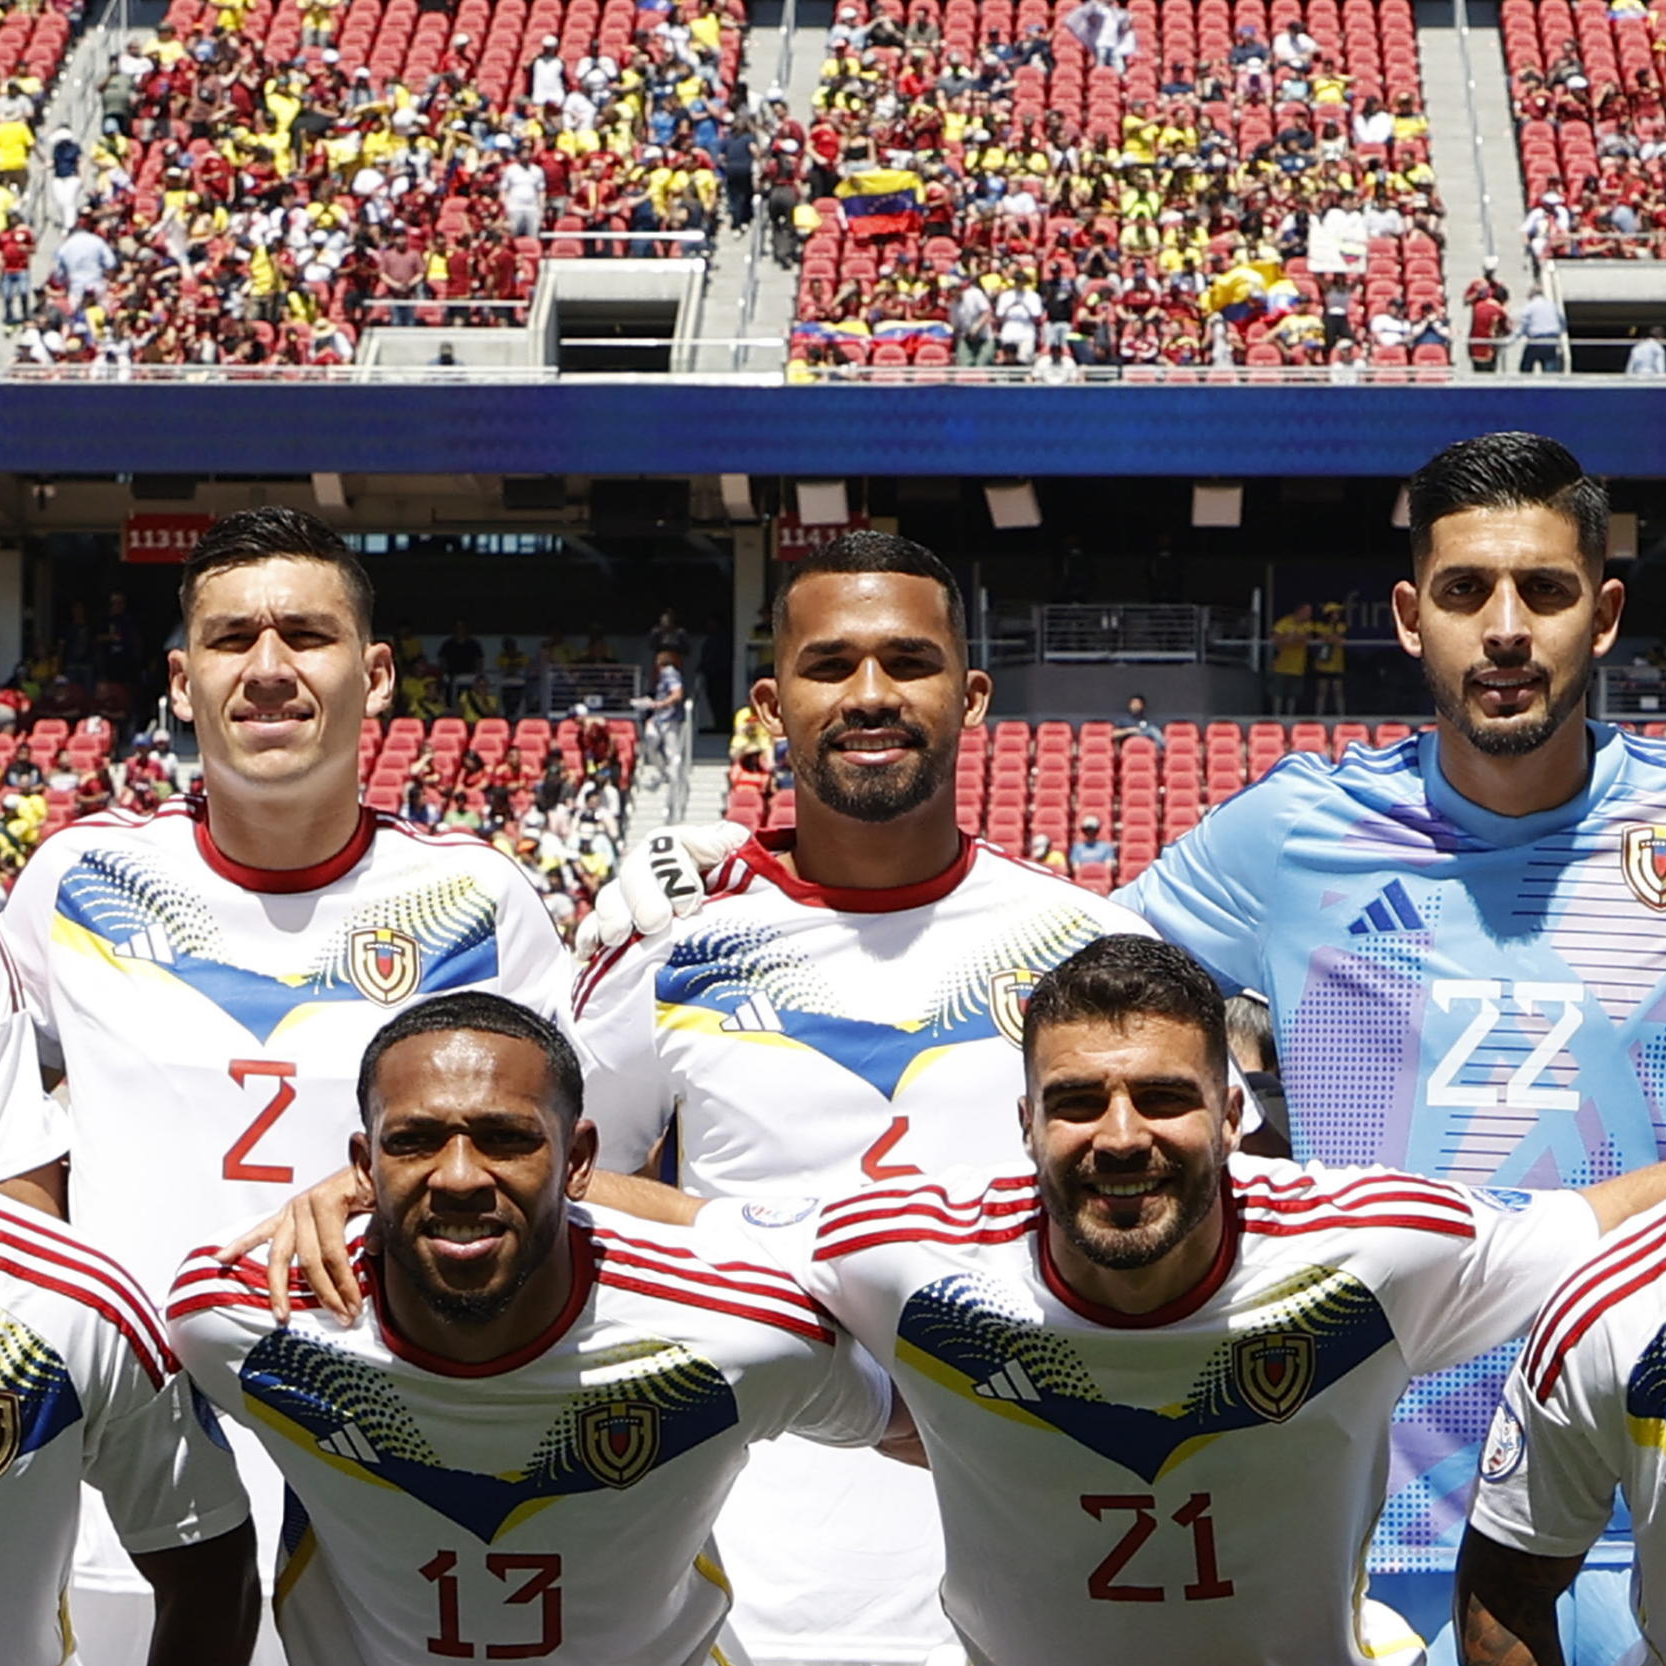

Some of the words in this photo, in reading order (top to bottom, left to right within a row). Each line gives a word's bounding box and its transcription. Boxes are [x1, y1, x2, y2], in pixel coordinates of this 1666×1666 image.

[1425, 979, 1587, 1113] 22
[221, 1058, 297, 1184] 2
[418, 1549, 563, 1660] 13
[1080, 1491, 1235, 1604] 21
